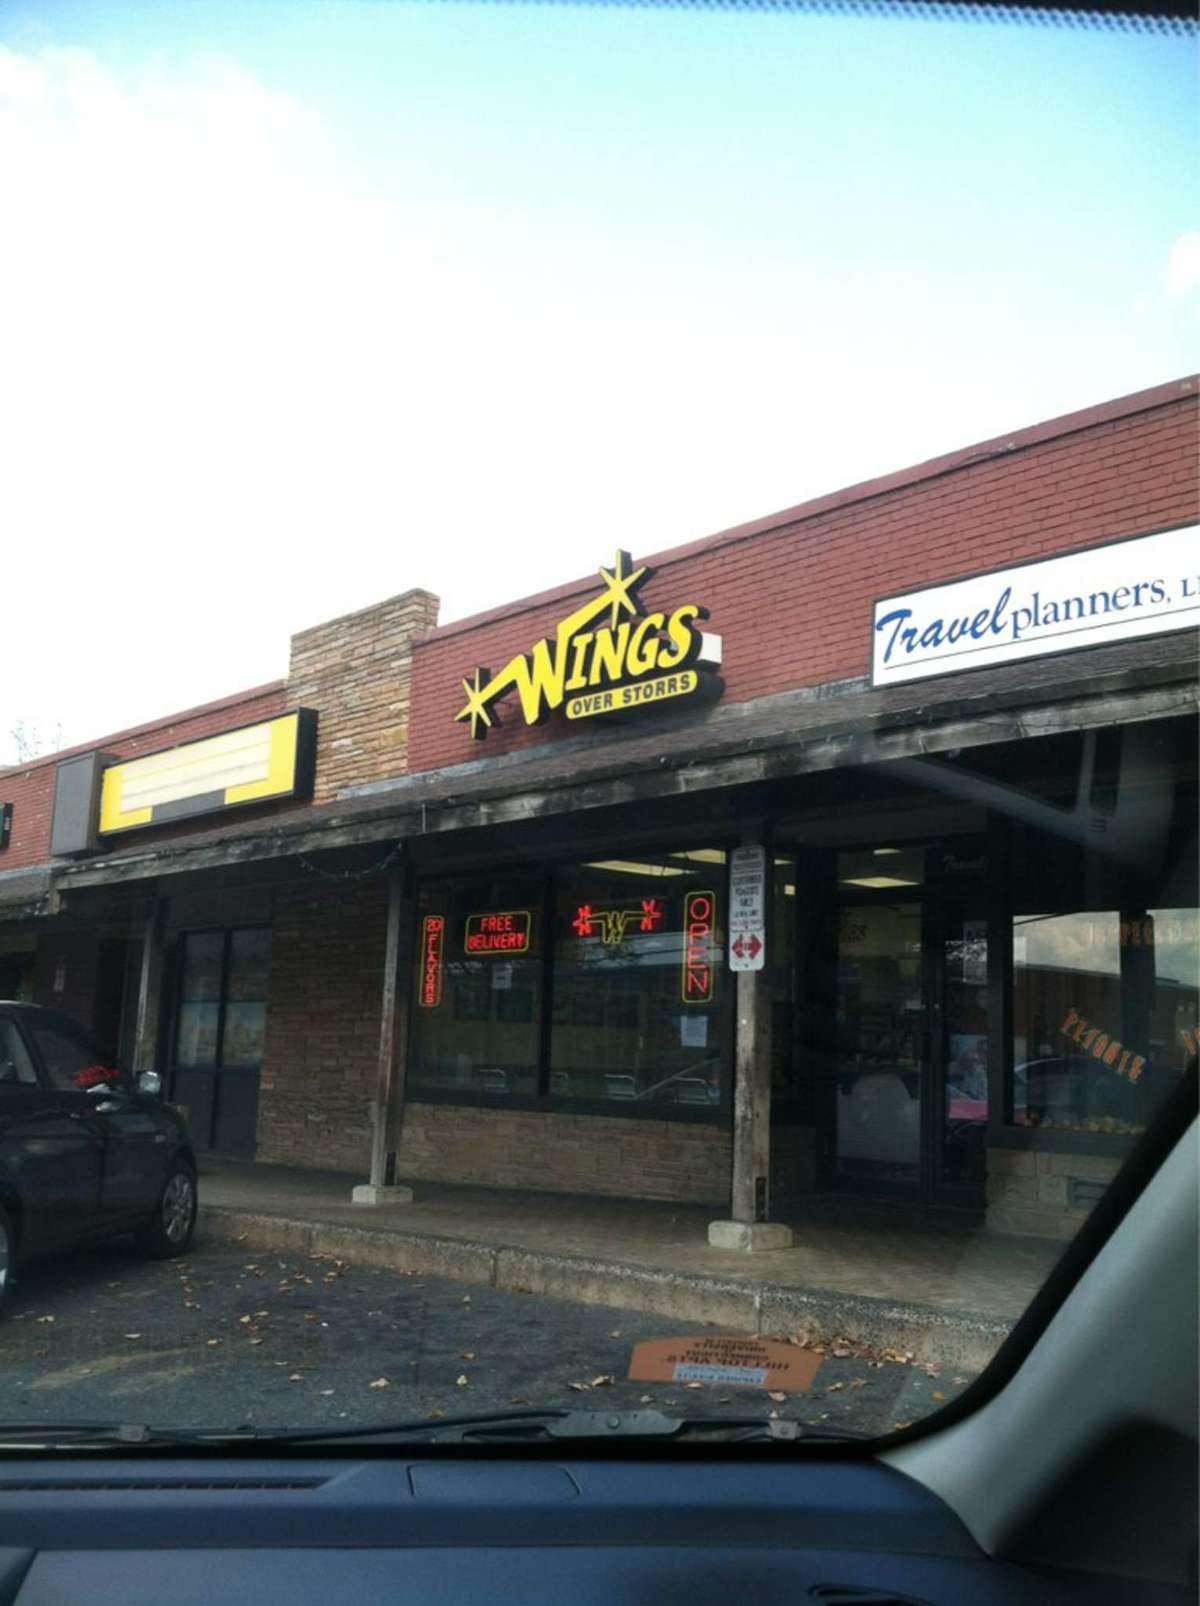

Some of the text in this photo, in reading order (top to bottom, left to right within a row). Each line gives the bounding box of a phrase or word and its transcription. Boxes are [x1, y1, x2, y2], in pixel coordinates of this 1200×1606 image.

[876, 586, 1012, 664] Travel
[484, 603, 700, 726] WINGS
[571, 673, 691, 716] OVER STORRS
[468, 933, 525, 951] DELIVERY
[480, 916, 513, 932] FREE
[687, 897, 711, 993] OPEN
